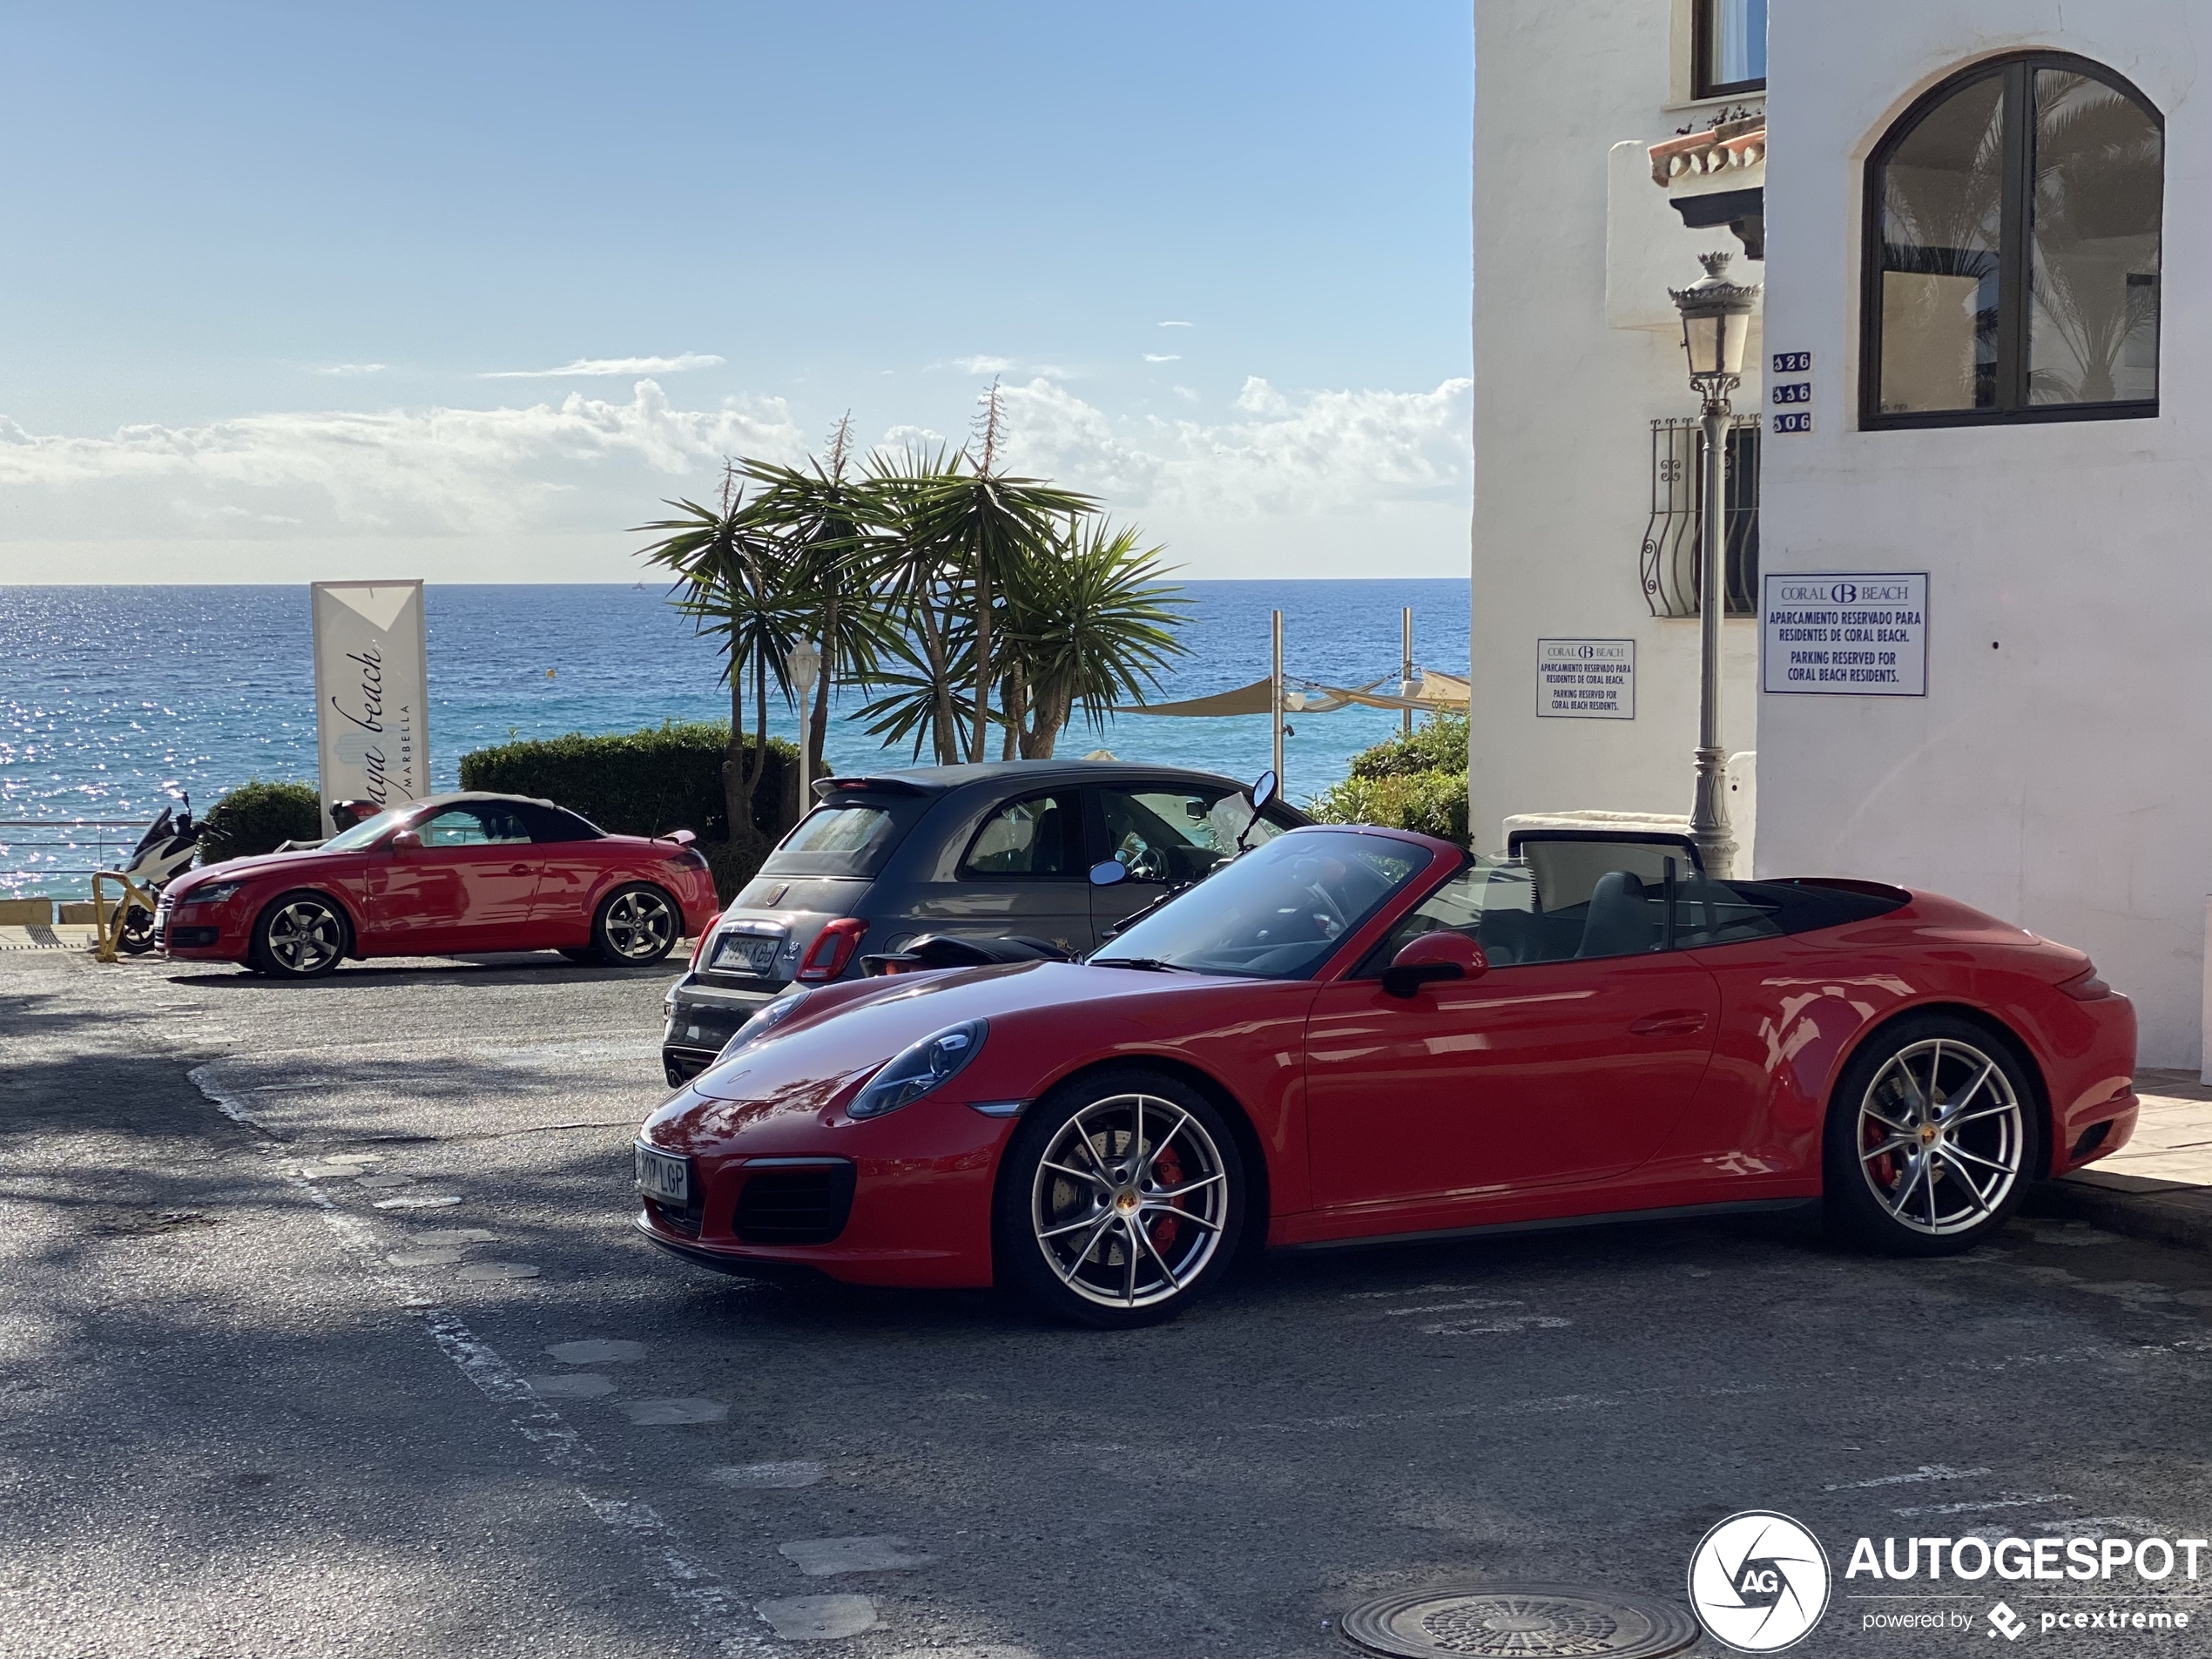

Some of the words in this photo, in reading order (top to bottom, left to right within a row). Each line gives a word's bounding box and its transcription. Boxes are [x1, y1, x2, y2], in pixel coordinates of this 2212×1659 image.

[1781, 587, 1827, 601] CORAL
[1861, 586, 1909, 600] BEACH
[1770, 611, 1838, 625] APARCAMIENTO
[1841, 611, 1892, 625] RESERVADO
[1895, 611, 1921, 625] PARA
[1779, 629, 1828, 642] RESIDENTES
[1831, 629, 1842, 642] DE
[1844, 629, 1874, 642] CORAL
[1878, 629, 1910, 643] BEACH.
[1548, 647, 1576, 657] CORAL
[1596, 648, 1624, 658] BEACH
[1791, 651, 1830, 664] PARKING
[1832, 651, 1876, 665] RESERVED
[1878, 652, 1897, 665] FOR
[1541, 664, 1582, 673] APARCAMIENTO
[1584, 664, 1615, 673] RESERVADO
[1615, 664, 1631, 674] PARA
[1788, 668, 1816, 681] CORAL
[1819, 668, 1847, 682] BEACH
[1850, 669, 1899, 683] RESIDENTS.
[1547, 675, 1576, 684] RESIDENTES
[1577, 675, 1585, 684] DE
[1586, 675, 1604, 685] CORAL
[1605, 676, 1625, 685] BEACH.
[331, 647, 382, 734] beach
[1554, 690, 1577, 698] PARKING
[1578, 690, 1605, 699] RESERVED
[1606, 691, 1617, 700] FOR
[1551, 700, 1569, 710] CORAL
[1571, 701, 1588, 711] BEACH
[1589, 701, 1620, 711] RESIDENTS.
[400, 705, 413, 788] MARBELLA
[659, 1160, 685, 1196] LGP
